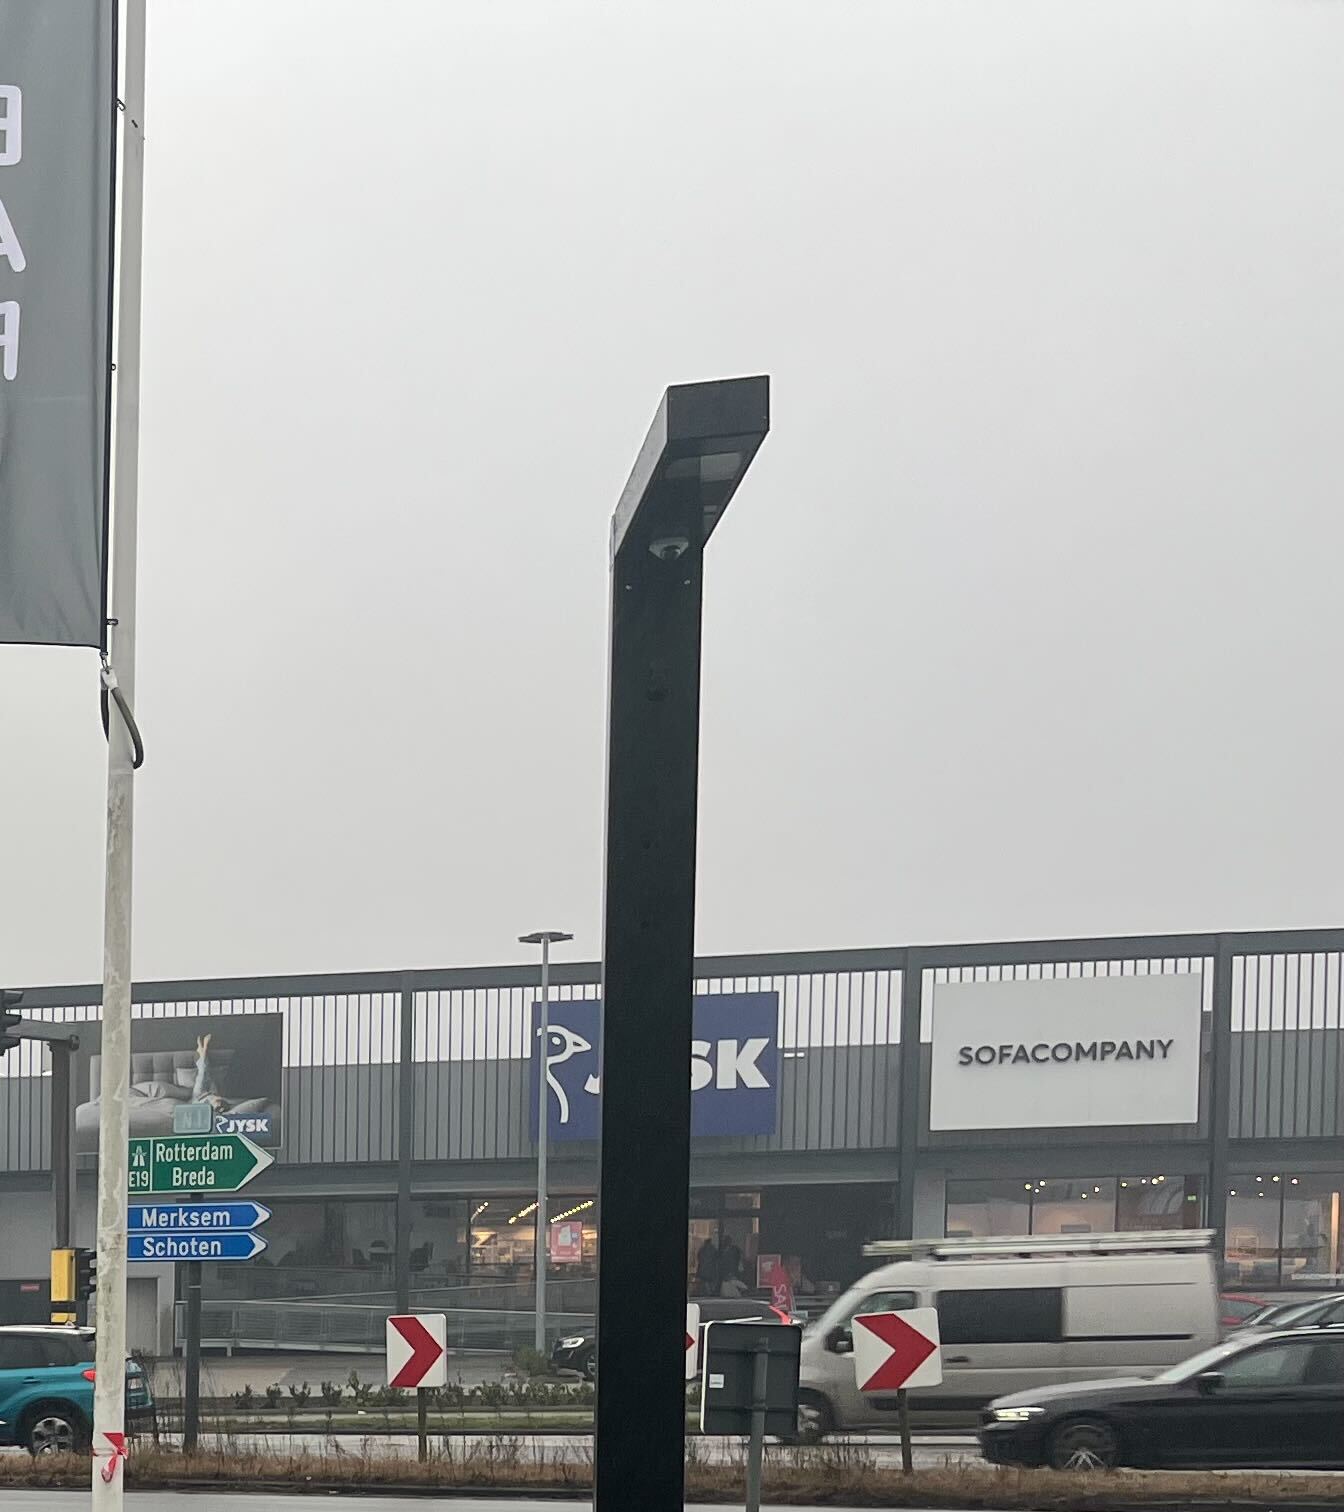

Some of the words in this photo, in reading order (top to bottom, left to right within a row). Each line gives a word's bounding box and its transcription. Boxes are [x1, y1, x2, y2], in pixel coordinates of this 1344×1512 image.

[958, 1039, 1174, 1066] SOFACOMPANY
[226, 1118, 269, 1133] JYSK
[156, 1141, 233, 1163] Rotterdam
[128, 1170, 150, 1188] E19
[172, 1166, 216, 1187] Breda
[141, 1207, 232, 1228] Merksem
[143, 1236, 222, 1257] Schoten
